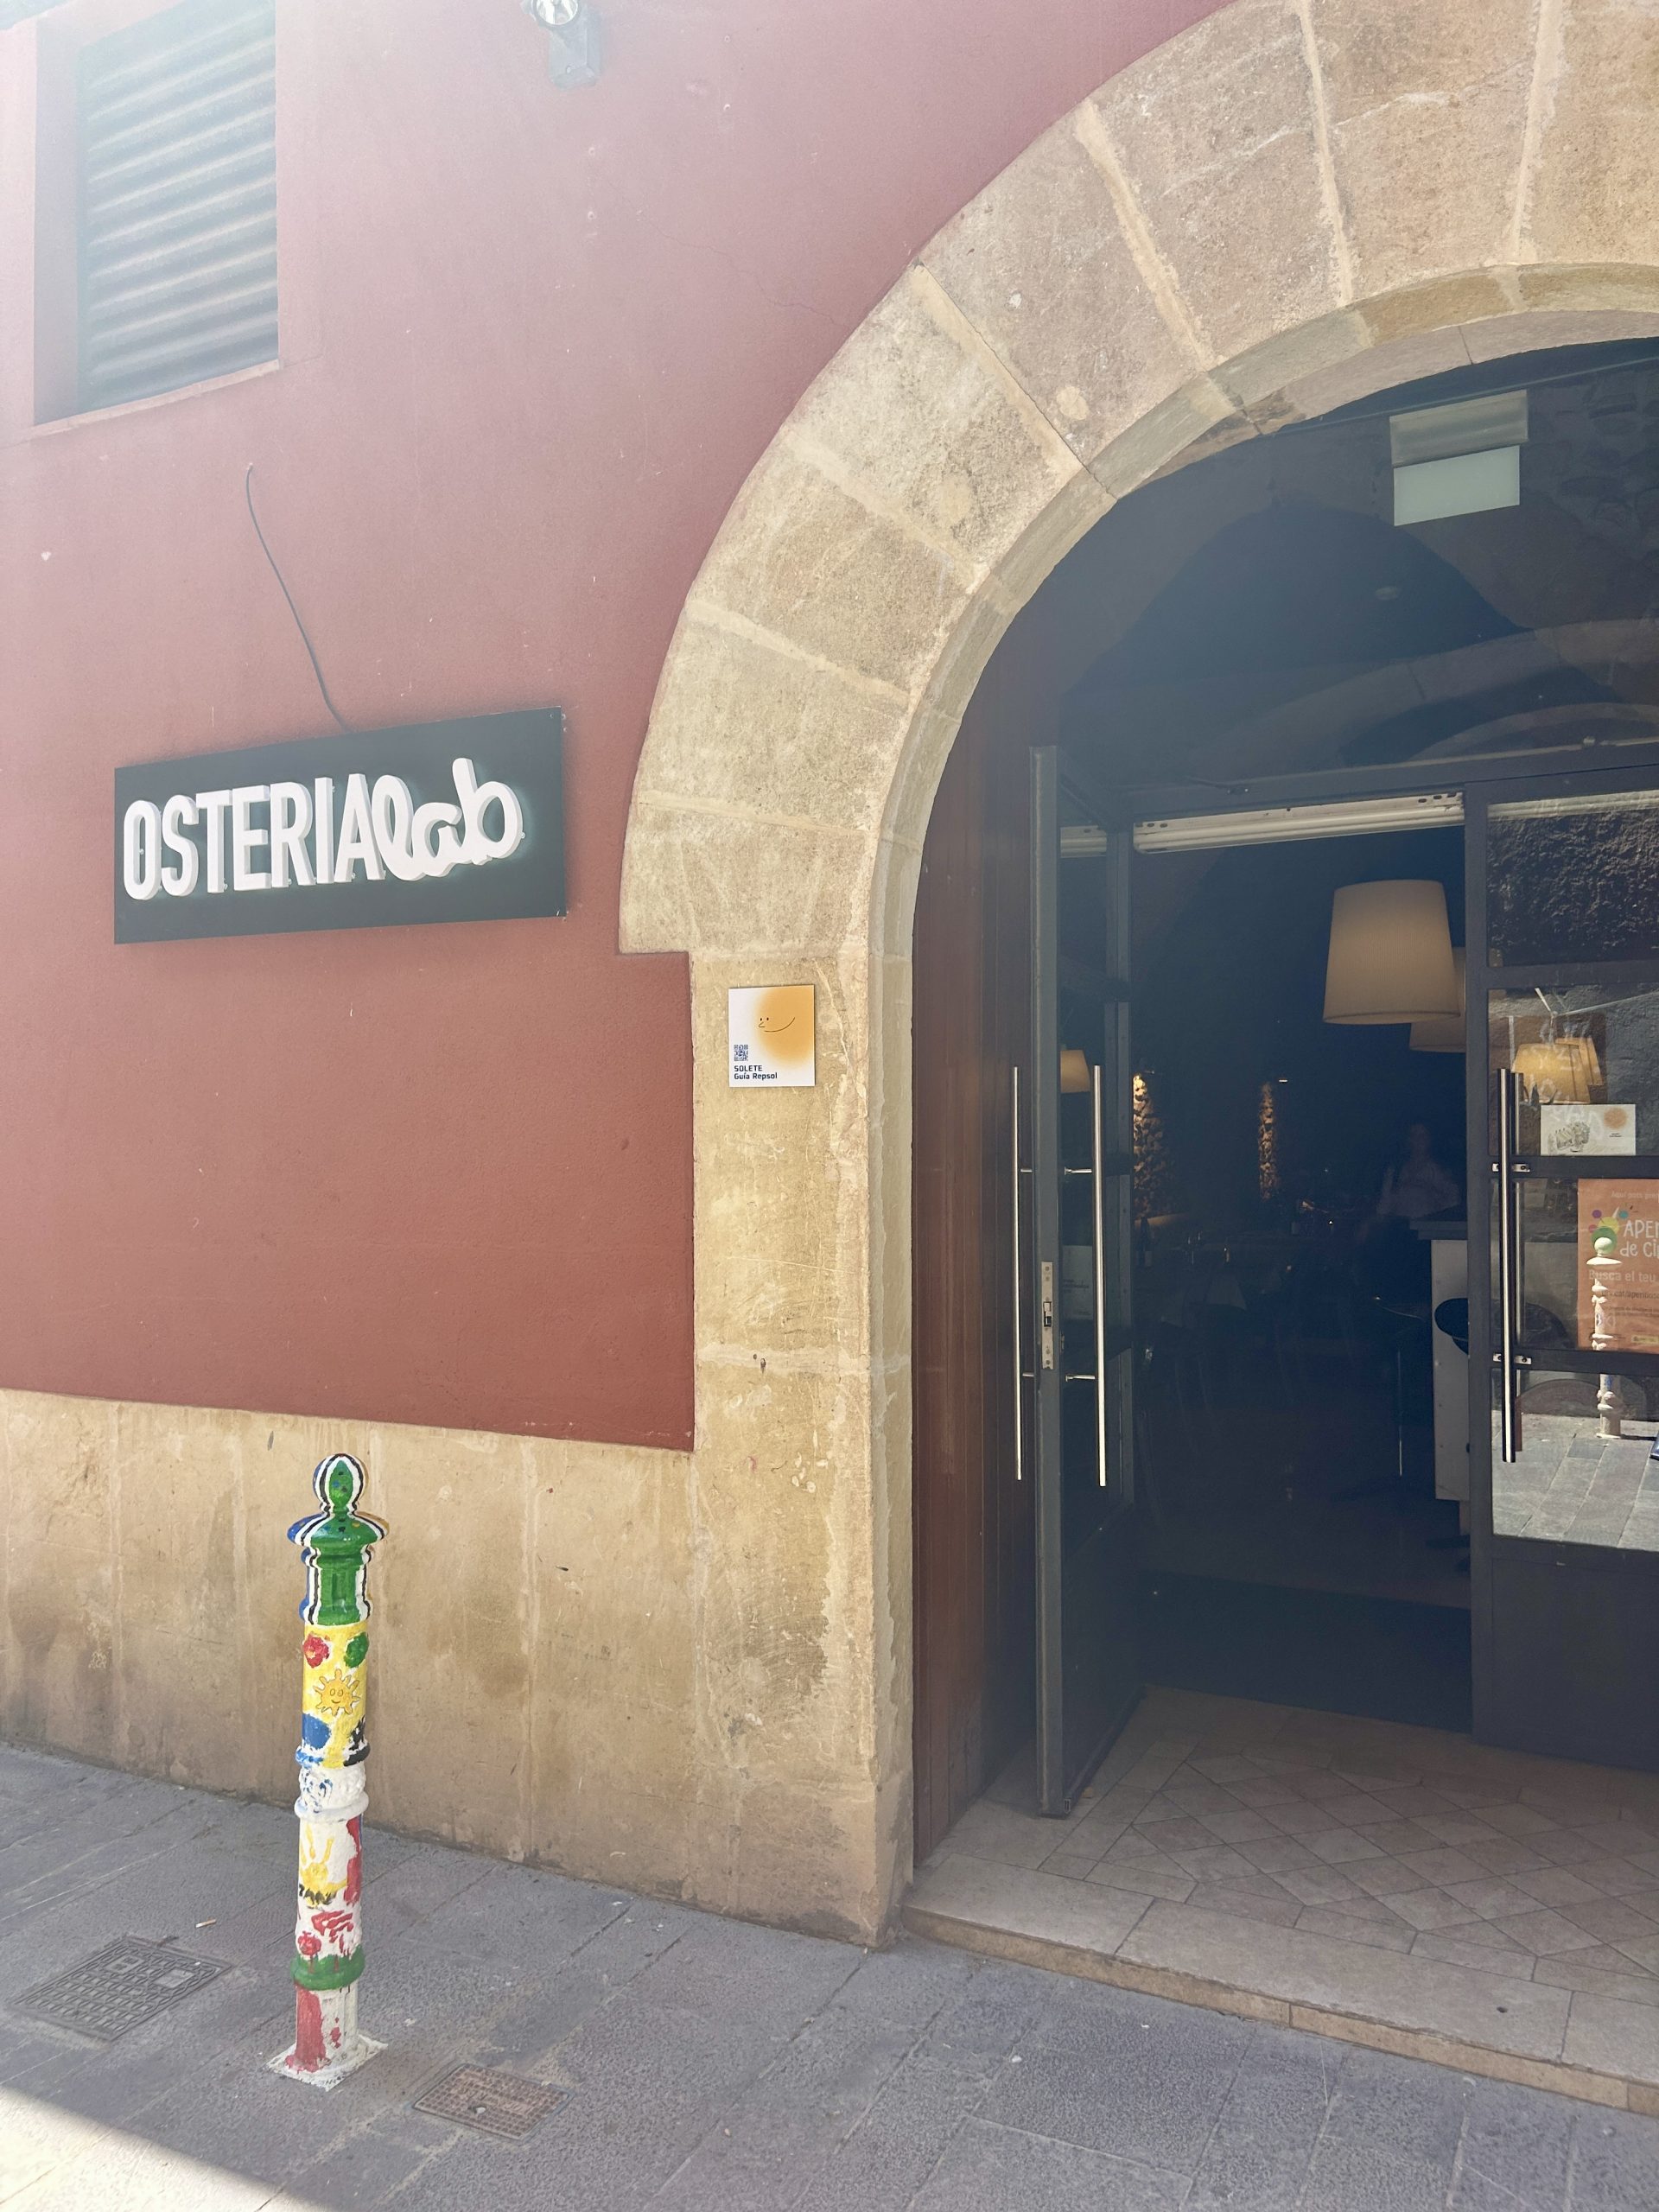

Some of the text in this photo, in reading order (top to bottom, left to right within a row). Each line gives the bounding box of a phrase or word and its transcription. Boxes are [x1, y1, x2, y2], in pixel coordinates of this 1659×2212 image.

[753, 1072, 778, 1081] Repsol
[1619, 1238, 1659, 1259] de Ci
[1589, 1268, 1656, 1283] Busca el teu
